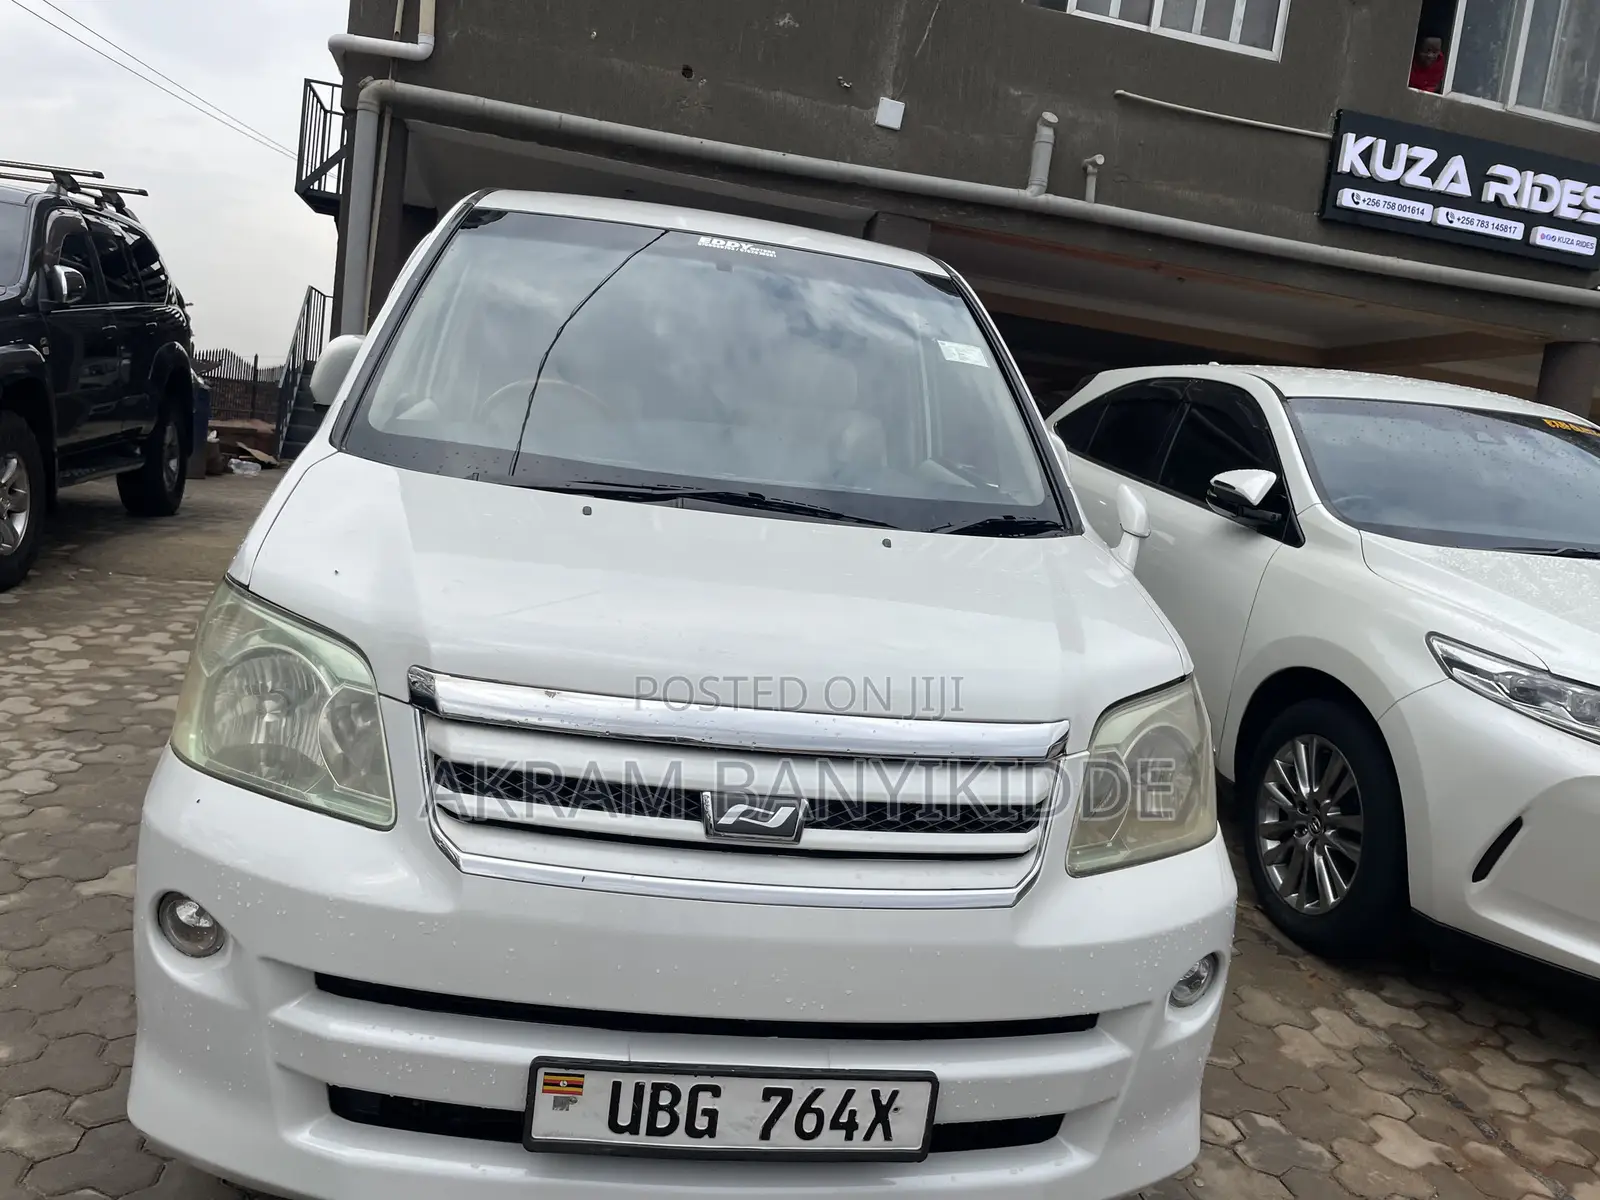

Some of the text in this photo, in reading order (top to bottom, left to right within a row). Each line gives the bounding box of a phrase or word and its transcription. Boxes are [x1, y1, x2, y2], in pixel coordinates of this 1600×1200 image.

[1338, 133, 1600, 225] KUZA RIDES
[1362, 197, 1425, 216] +256 758 001614
[1456, 215, 1518, 234] +256 783 145817
[698, 236, 754, 250] EDDY
[1557, 236, 1595, 249] KUZA RIDES
[607, 1080, 900, 1142] UBG 764X
